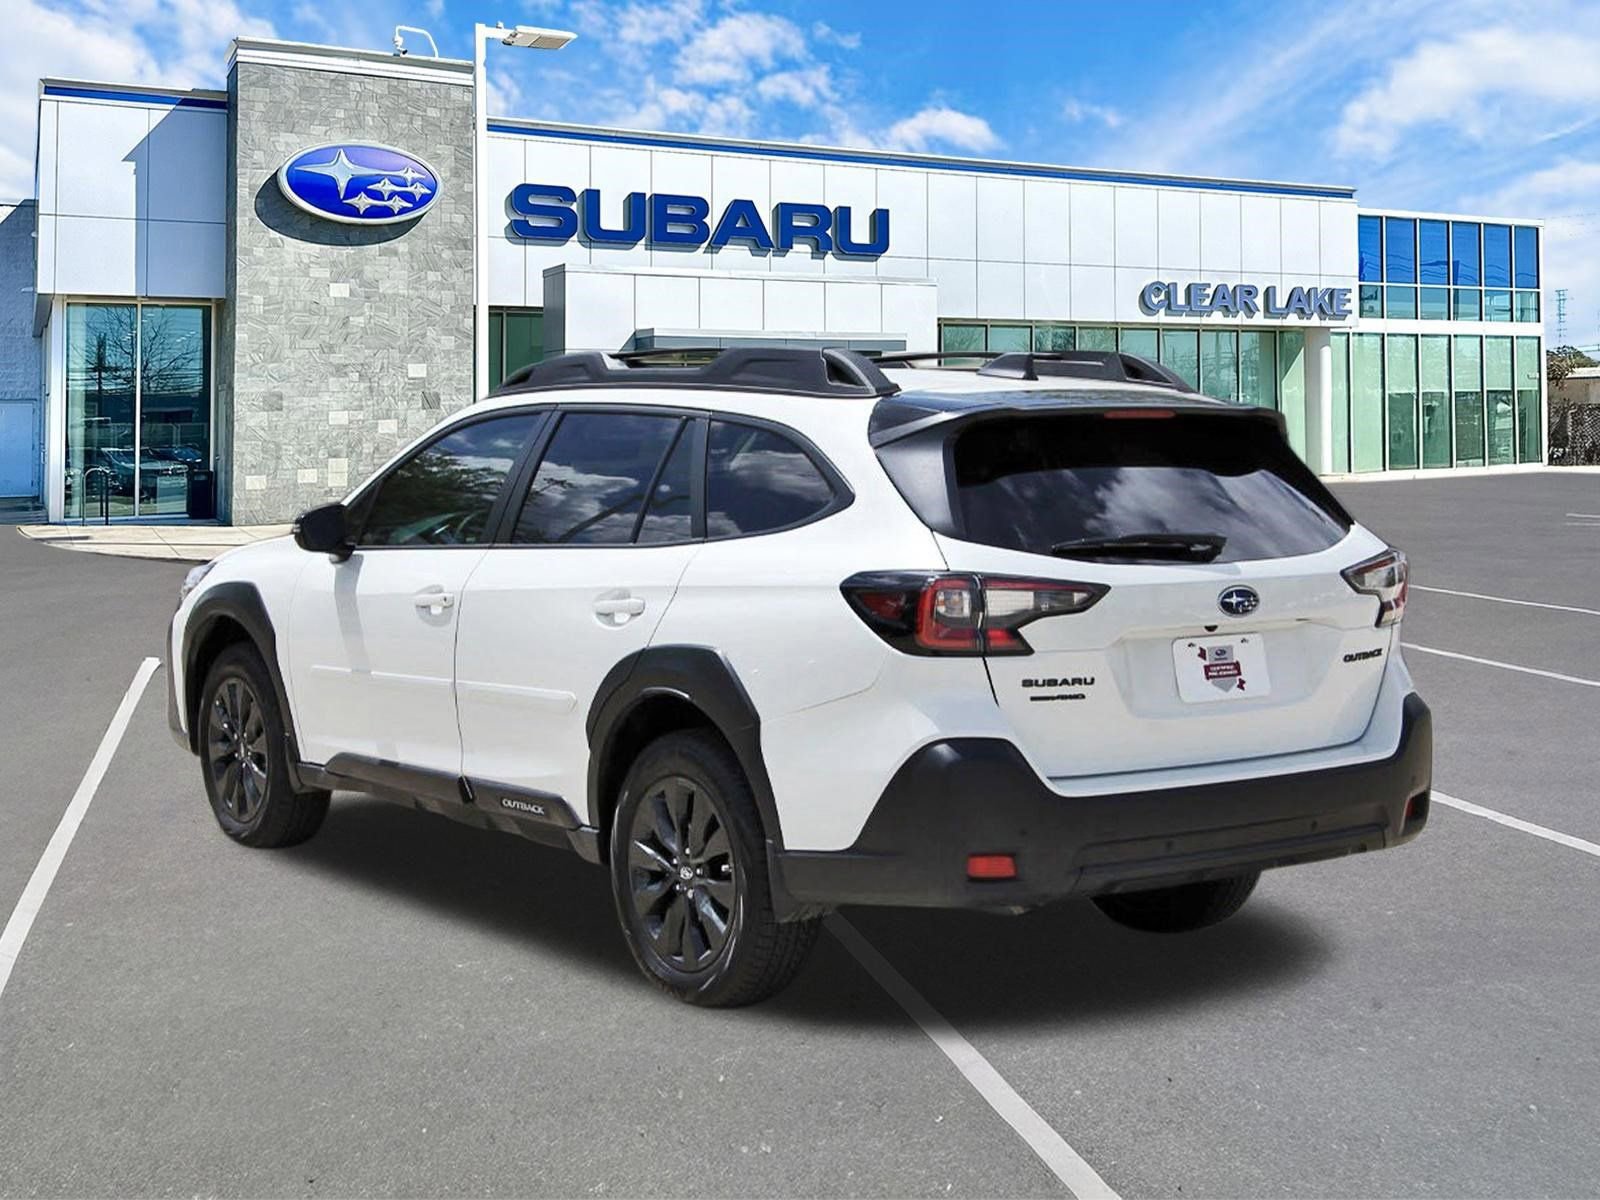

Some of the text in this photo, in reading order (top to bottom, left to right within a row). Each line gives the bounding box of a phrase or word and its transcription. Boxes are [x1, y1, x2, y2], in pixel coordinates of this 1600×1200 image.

[506, 183, 889, 258] SUBARU
[1140, 281, 1352, 318] CLEAR LAKE
[1343, 648, 1382, 662] OUTBACK
[1022, 677, 1095, 687] SUBARU
[502, 799, 544, 814] OUTBACK
